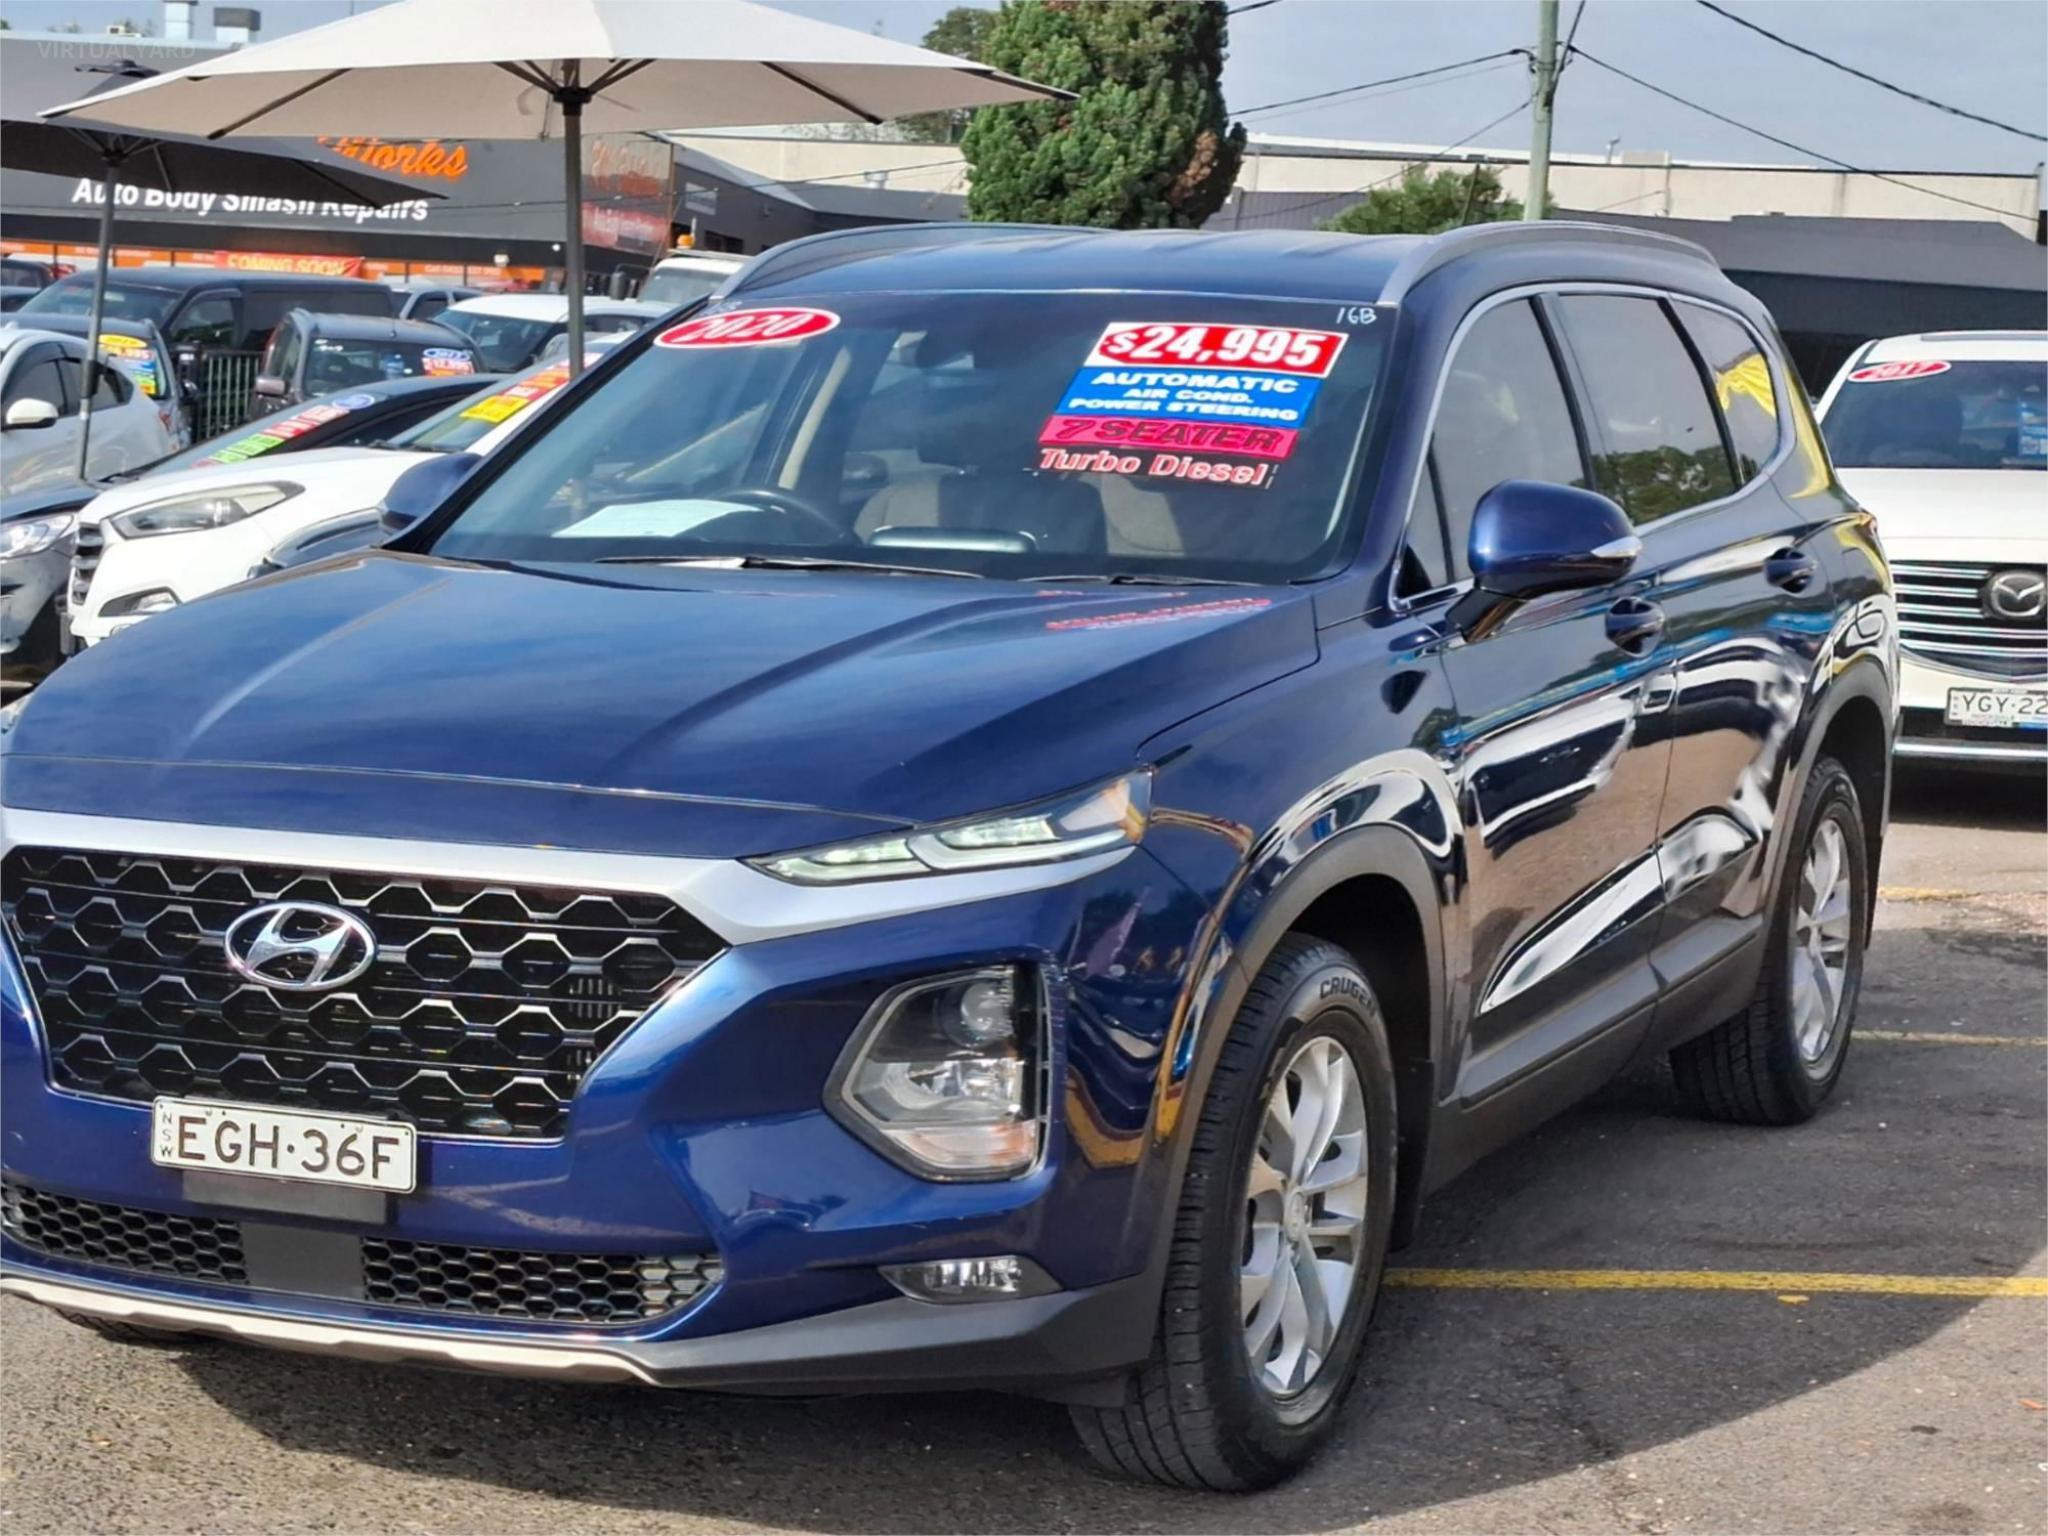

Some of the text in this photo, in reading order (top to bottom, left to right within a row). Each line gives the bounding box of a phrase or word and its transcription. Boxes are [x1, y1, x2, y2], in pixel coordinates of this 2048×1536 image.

[72, 178, 139, 205] Auto
[227, 253, 292, 271] COMING
[297, 259, 345, 276] SOON
[669, 314, 814, 343] 2020
[1106, 325, 1323, 366] $24,995
[1091, 372, 1299, 393] AUTOMATIC
[1123, 388, 1254, 403] AIR COND.
[1068, 398, 1299, 421] POWER STEERING
[1056, 419, 1283, 451] 7 SEATER
[1040, 447, 1269, 486] Turbo Diesel
